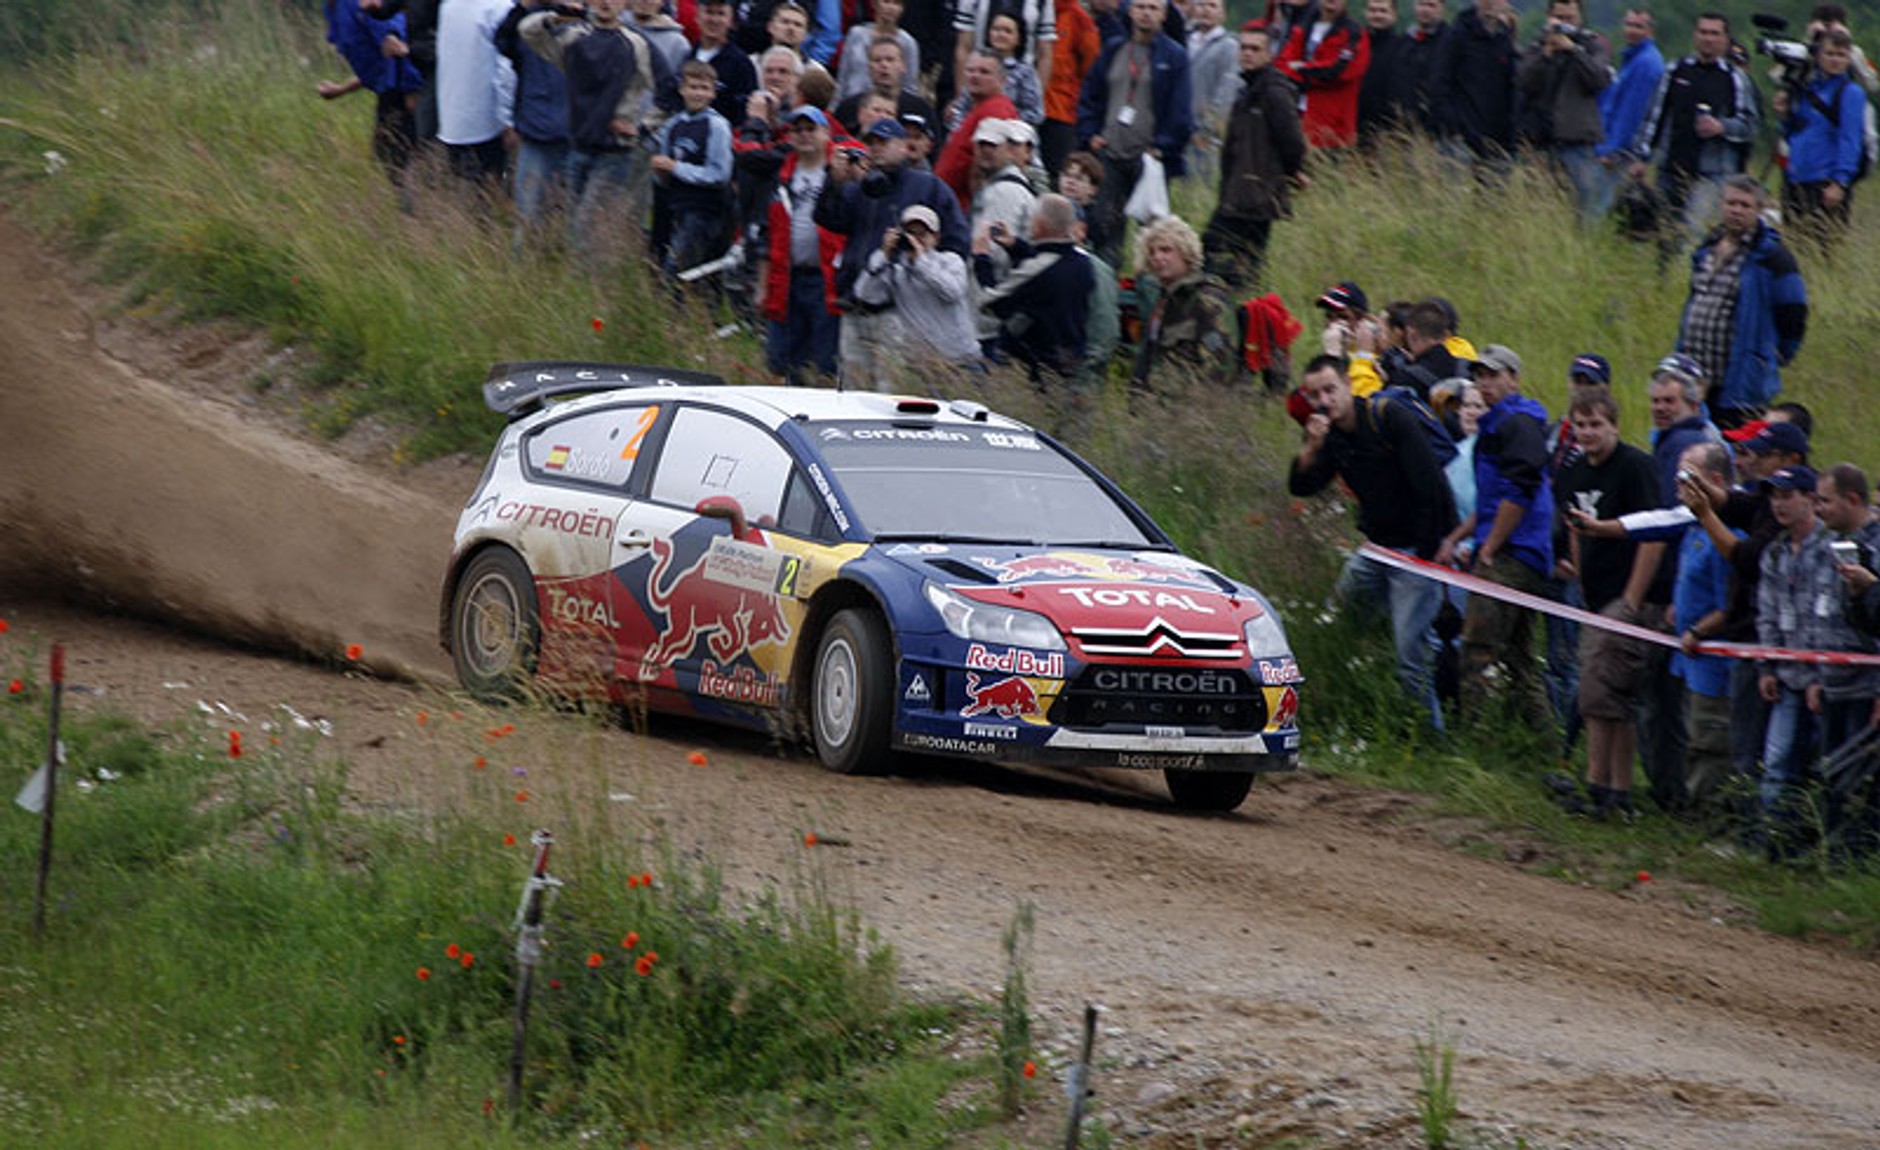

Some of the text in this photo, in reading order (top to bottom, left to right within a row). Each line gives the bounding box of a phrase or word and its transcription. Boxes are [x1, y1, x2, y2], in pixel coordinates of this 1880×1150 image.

[620, 404, 660, 461] 2
[780, 558, 798, 594] 2
[547, 588, 621, 629] TOTAL
[1058, 587, 1215, 613] TOTAL
[966, 643, 1064, 678] Red Bull
[698, 659, 777, 705] Red Bull
